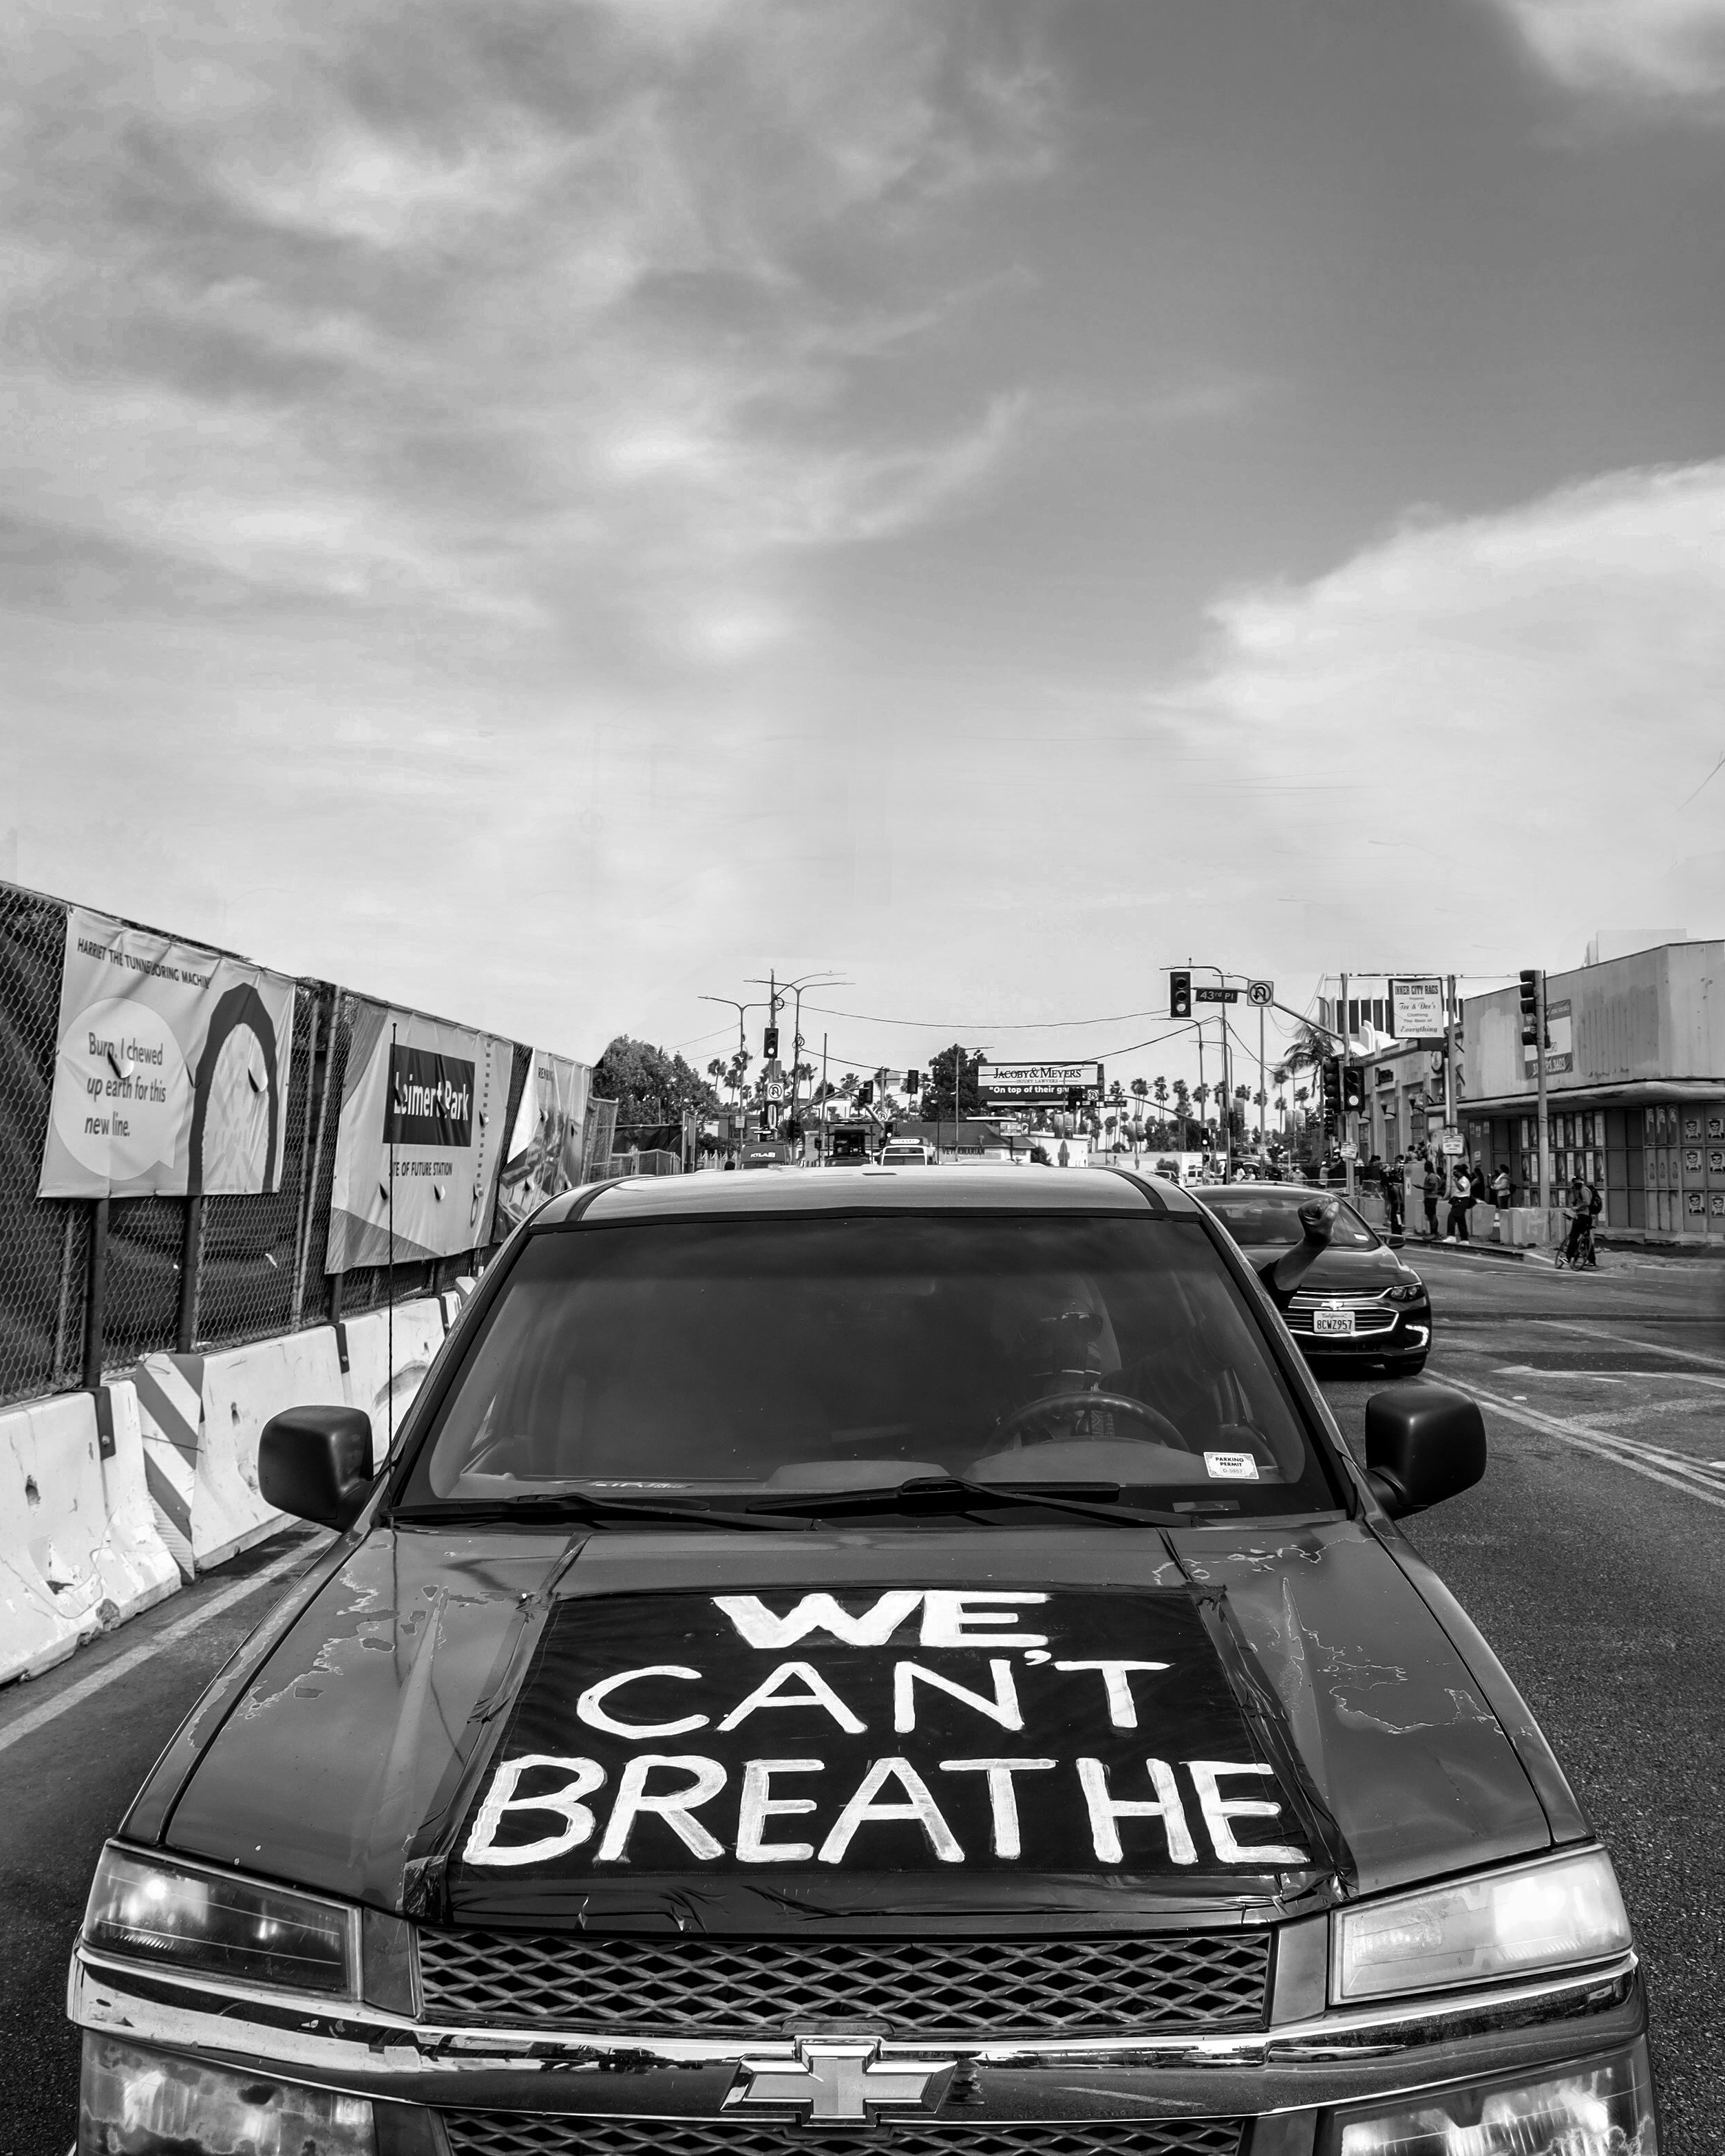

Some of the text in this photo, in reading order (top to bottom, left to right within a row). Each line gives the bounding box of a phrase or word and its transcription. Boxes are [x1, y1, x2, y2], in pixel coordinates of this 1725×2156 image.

[77, 937, 106, 960] HARRIET
[108, 949, 123, 965] THE
[1200, 991, 1223, 1000] 43rd
[1395, 985, 1439, 995] INNER CITY RAGS
[1399, 1025, 1439, 1034] Everything
[120, 1038, 125, 1060] I
[126, 1037, 164, 1066] chewed
[87, 1075, 167, 1103] up earth for this
[1008, 1087, 1022, 1095] top
[1035, 1085, 1055, 1093] their
[444, 1080, 470, 1121] Park
[84, 1116, 110, 1135] new
[942, 1146, 985, 1155] VETRINARIAN
[401, 1162, 410, 1177] OF
[411, 1162, 432, 1177] FUTURE
[433, 1162, 453, 1177] STATION
[1317, 1319, 1353, 1330] 8CWZ957
[710, 1590, 1048, 1648] WE
[577, 1650, 1170, 1739] CAN'T
[463, 1754, 1307, 1866] BREATHE
